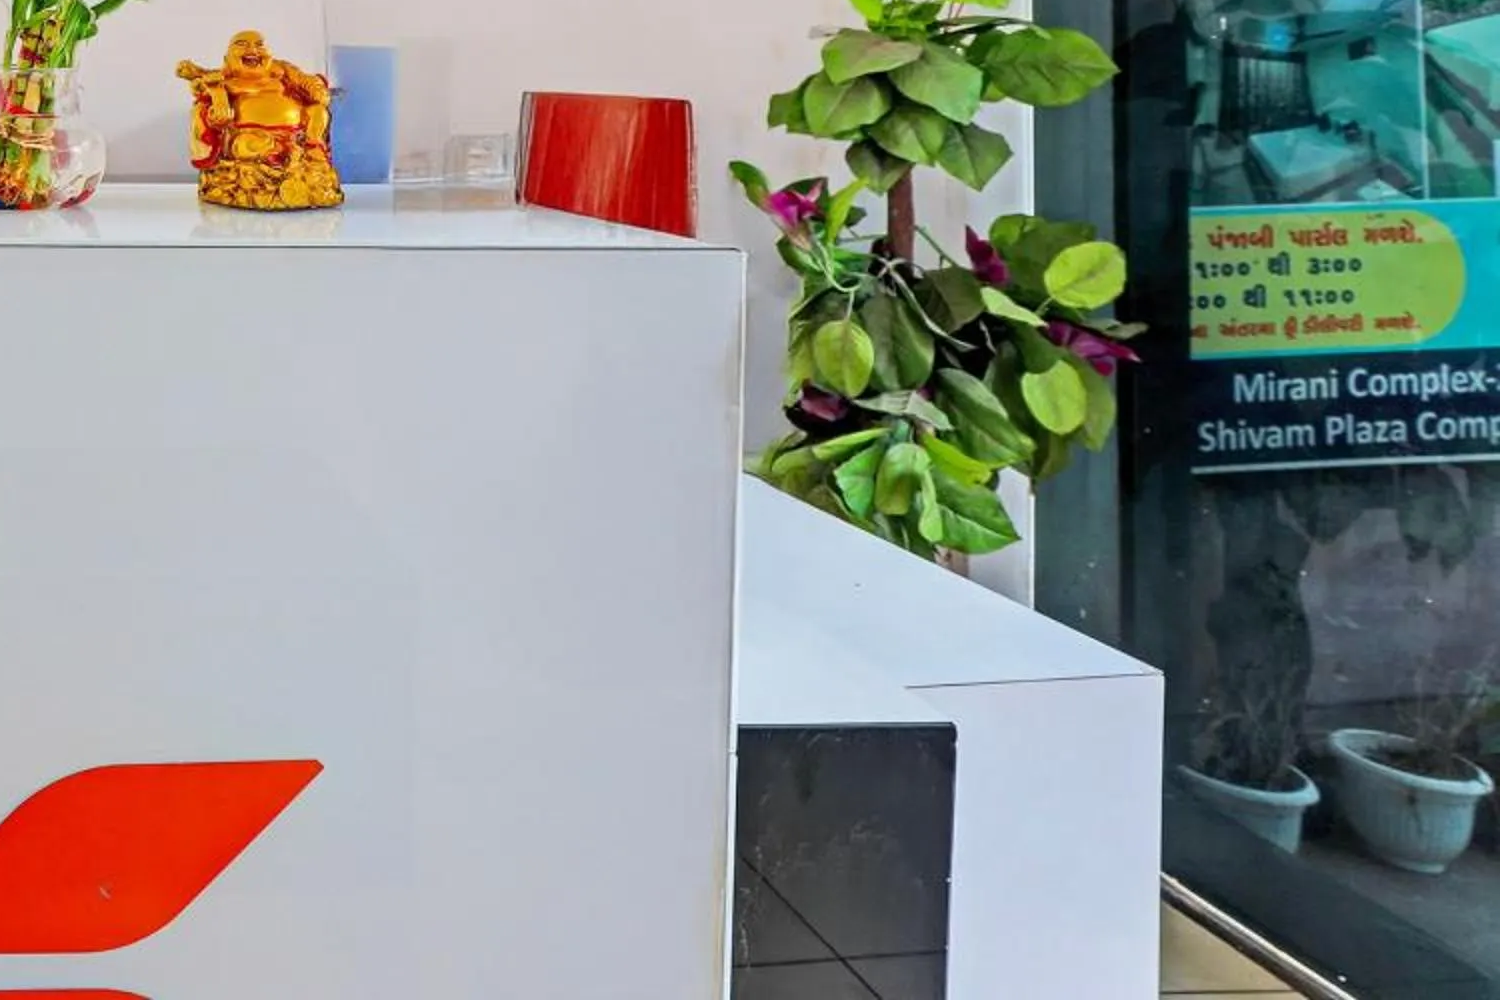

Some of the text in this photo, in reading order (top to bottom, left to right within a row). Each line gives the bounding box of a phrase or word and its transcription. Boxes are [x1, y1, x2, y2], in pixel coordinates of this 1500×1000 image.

[1232, 362, 1500, 403] Mirani Complex-
[1197, 418, 1316, 452] Shivam
[1325, 413, 1408, 446] Plaza
